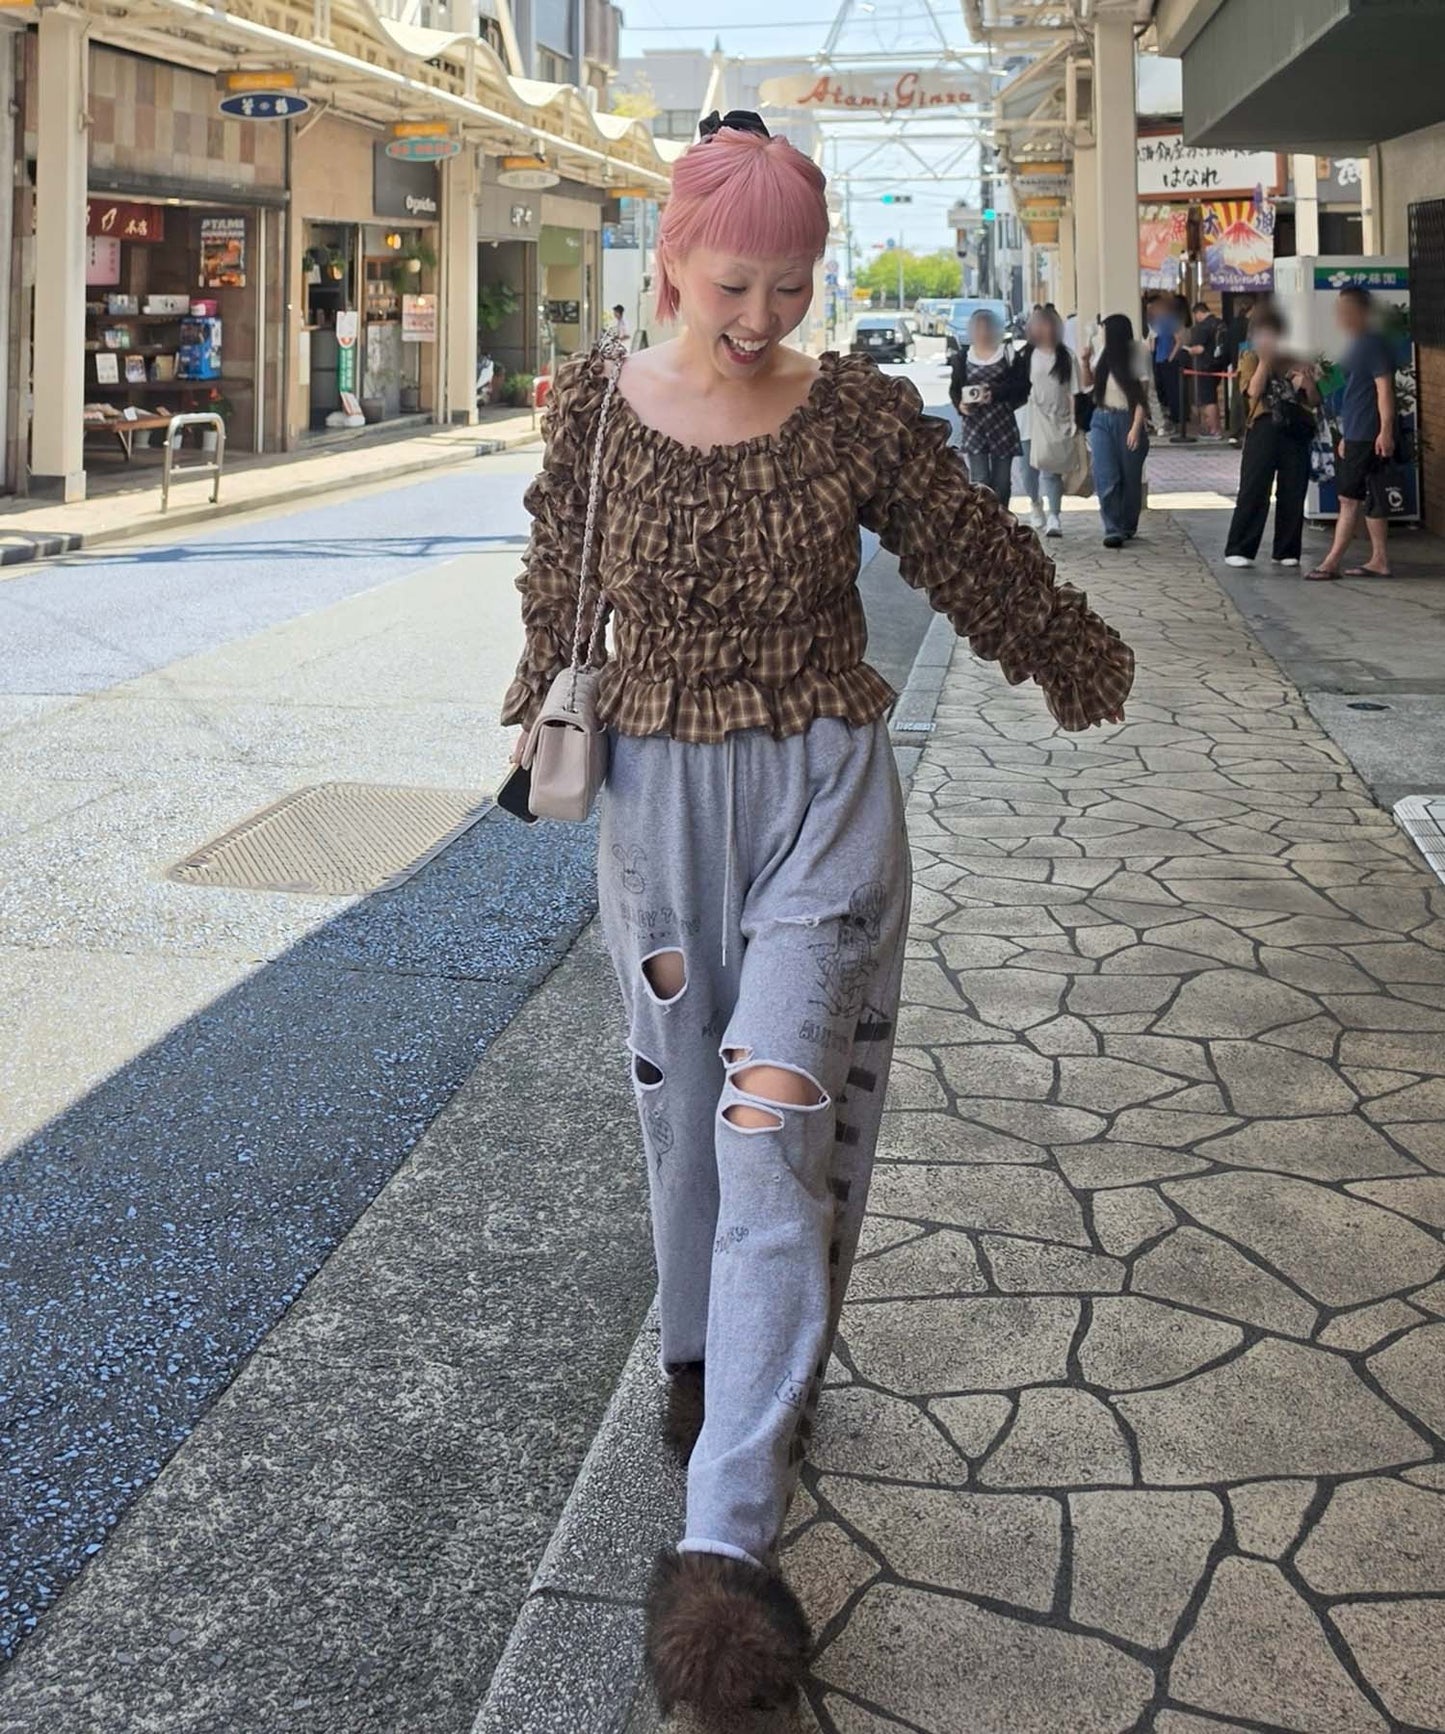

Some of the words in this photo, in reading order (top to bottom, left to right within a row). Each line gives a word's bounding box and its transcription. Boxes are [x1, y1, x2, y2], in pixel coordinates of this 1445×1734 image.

[798, 77, 889, 107] Atami
[896, 72, 972, 108] Ginza
[1163, 166, 1222, 188] はなれ
